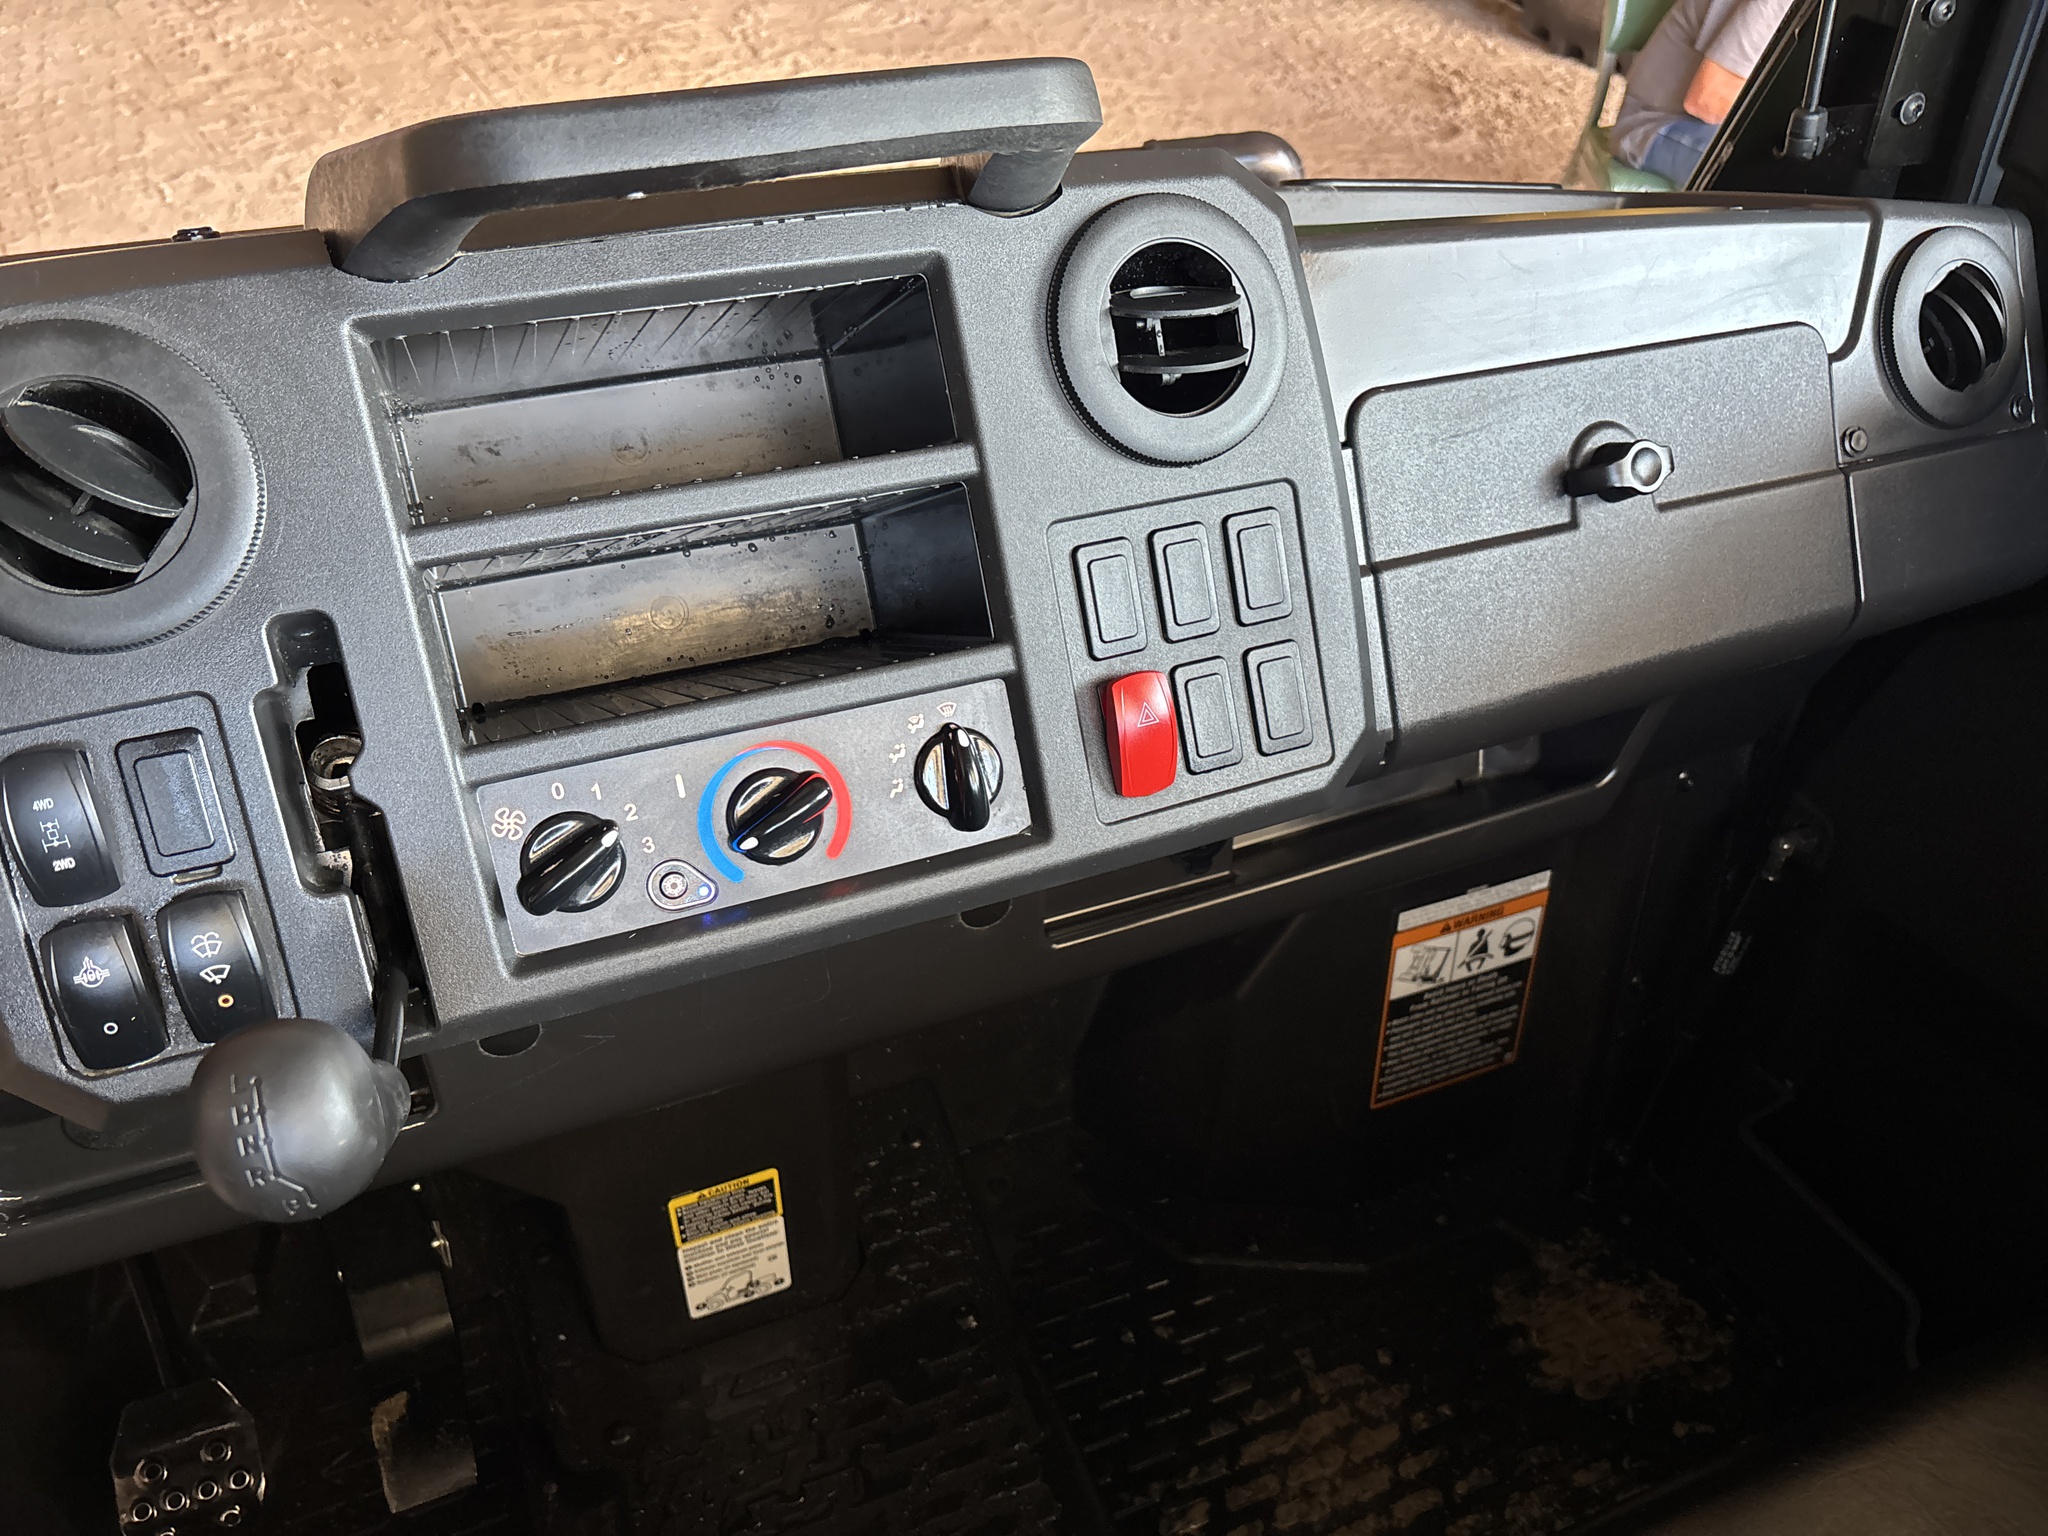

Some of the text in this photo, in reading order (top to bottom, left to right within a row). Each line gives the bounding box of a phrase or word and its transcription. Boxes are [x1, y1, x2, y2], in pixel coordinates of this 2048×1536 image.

[551, 782, 565, 800] 0
[590, 782, 602, 801] 1
[32, 797, 55, 812] 4WD
[623, 803, 639, 822] 2
[641, 836, 656, 854] 3
[52, 857, 76, 872] 2WD
[1453, 905, 1505, 929] WARNING
[244, 1167, 266, 1189] R
[707, 1178, 750, 1197] CAUTION
